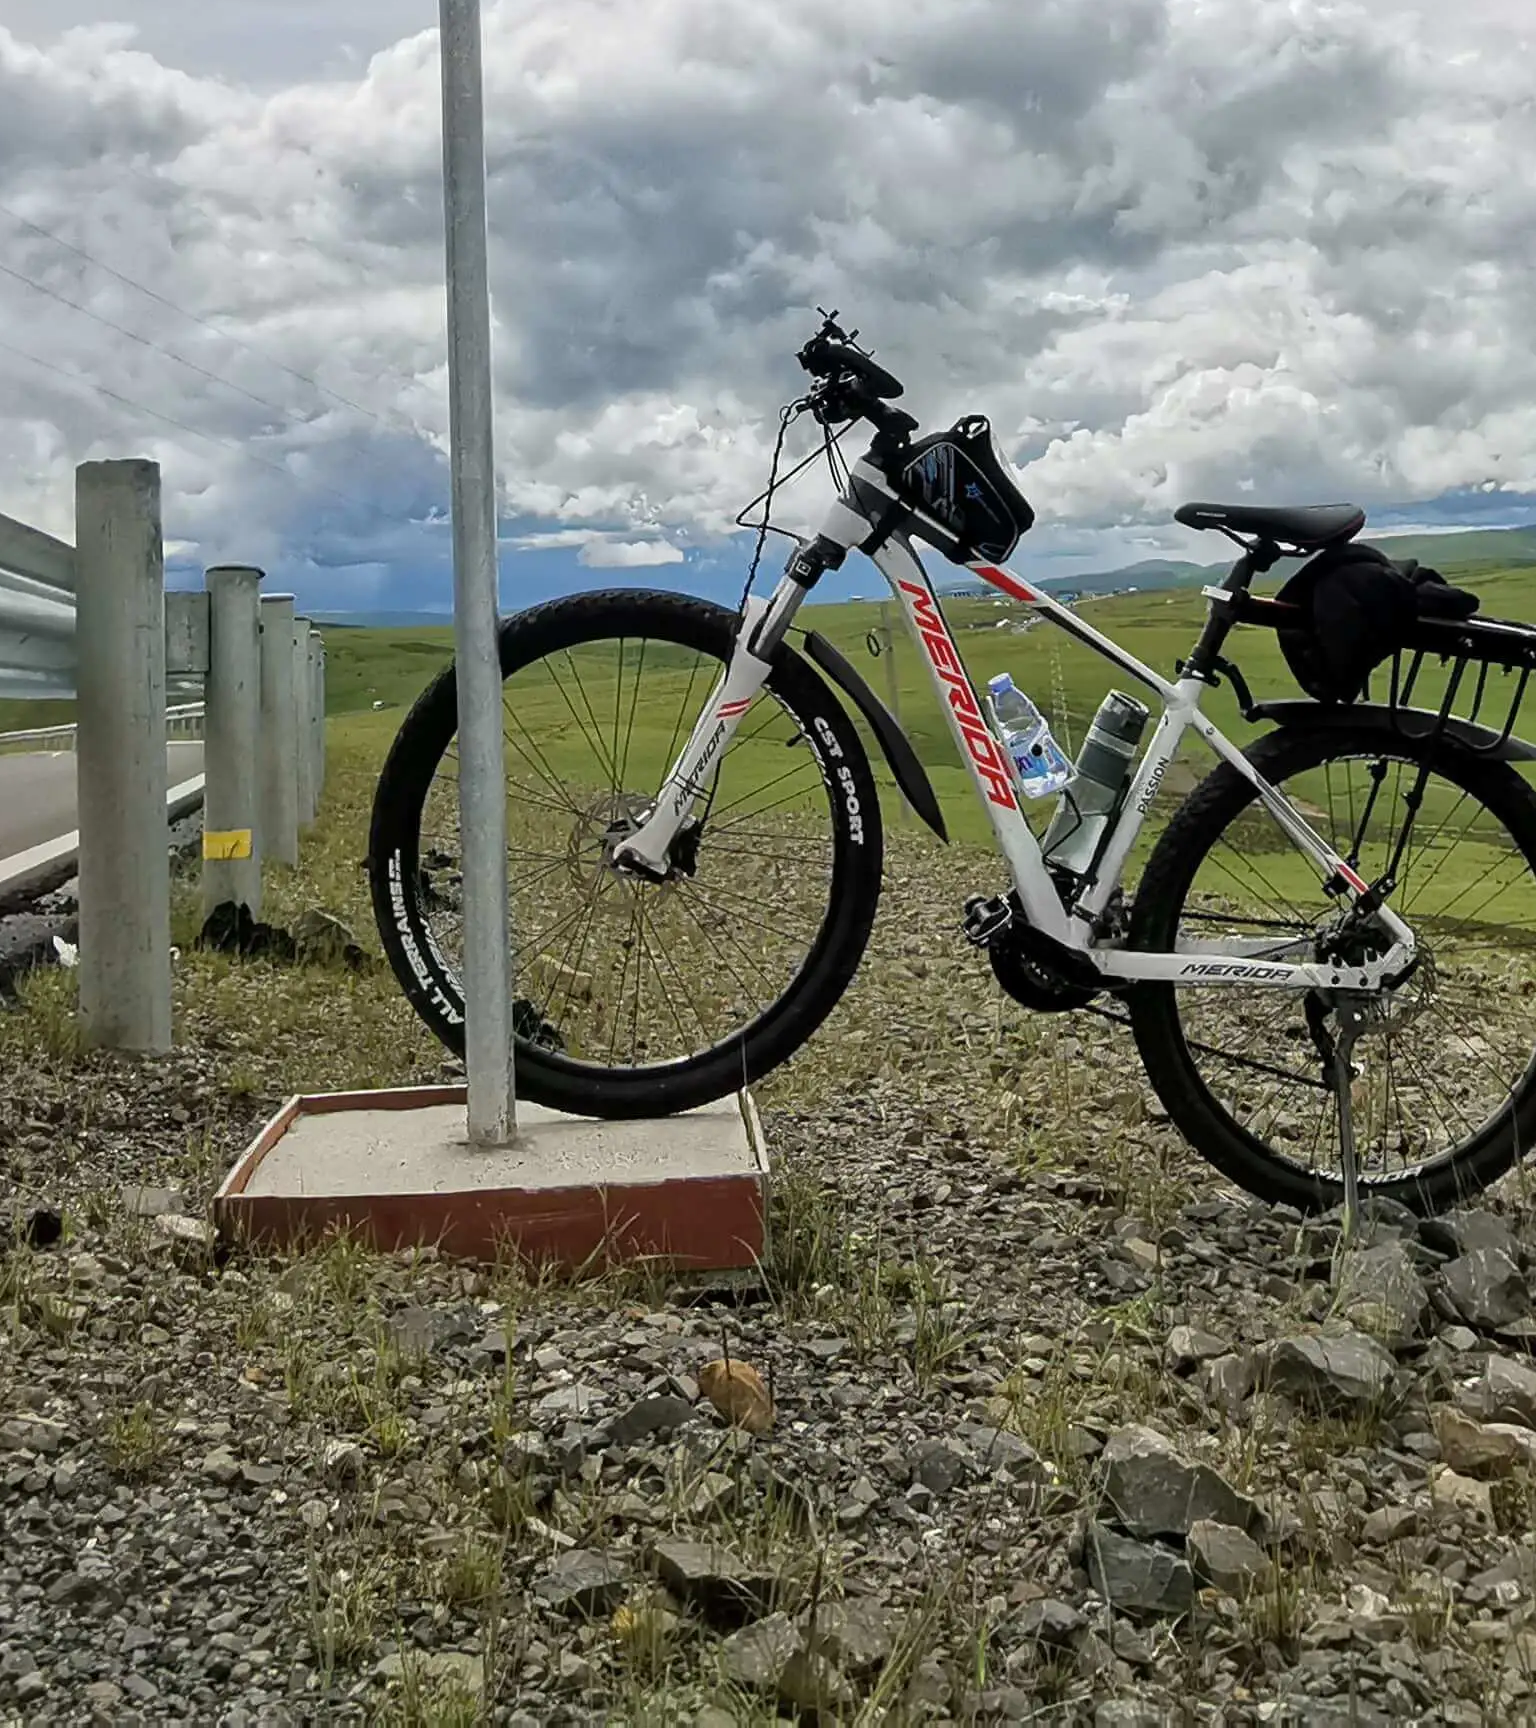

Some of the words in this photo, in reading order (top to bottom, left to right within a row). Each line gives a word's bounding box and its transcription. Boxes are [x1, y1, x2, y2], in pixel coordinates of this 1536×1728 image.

[897, 578, 1018, 811] MERIDA
[814, 716, 844, 759] CST
[836, 765, 864, 846] SPORT
[1136, 756, 1170, 815] PASSION
[1179, 963, 1295, 981] MERIDA
[430, 985, 465, 1024] ALL
